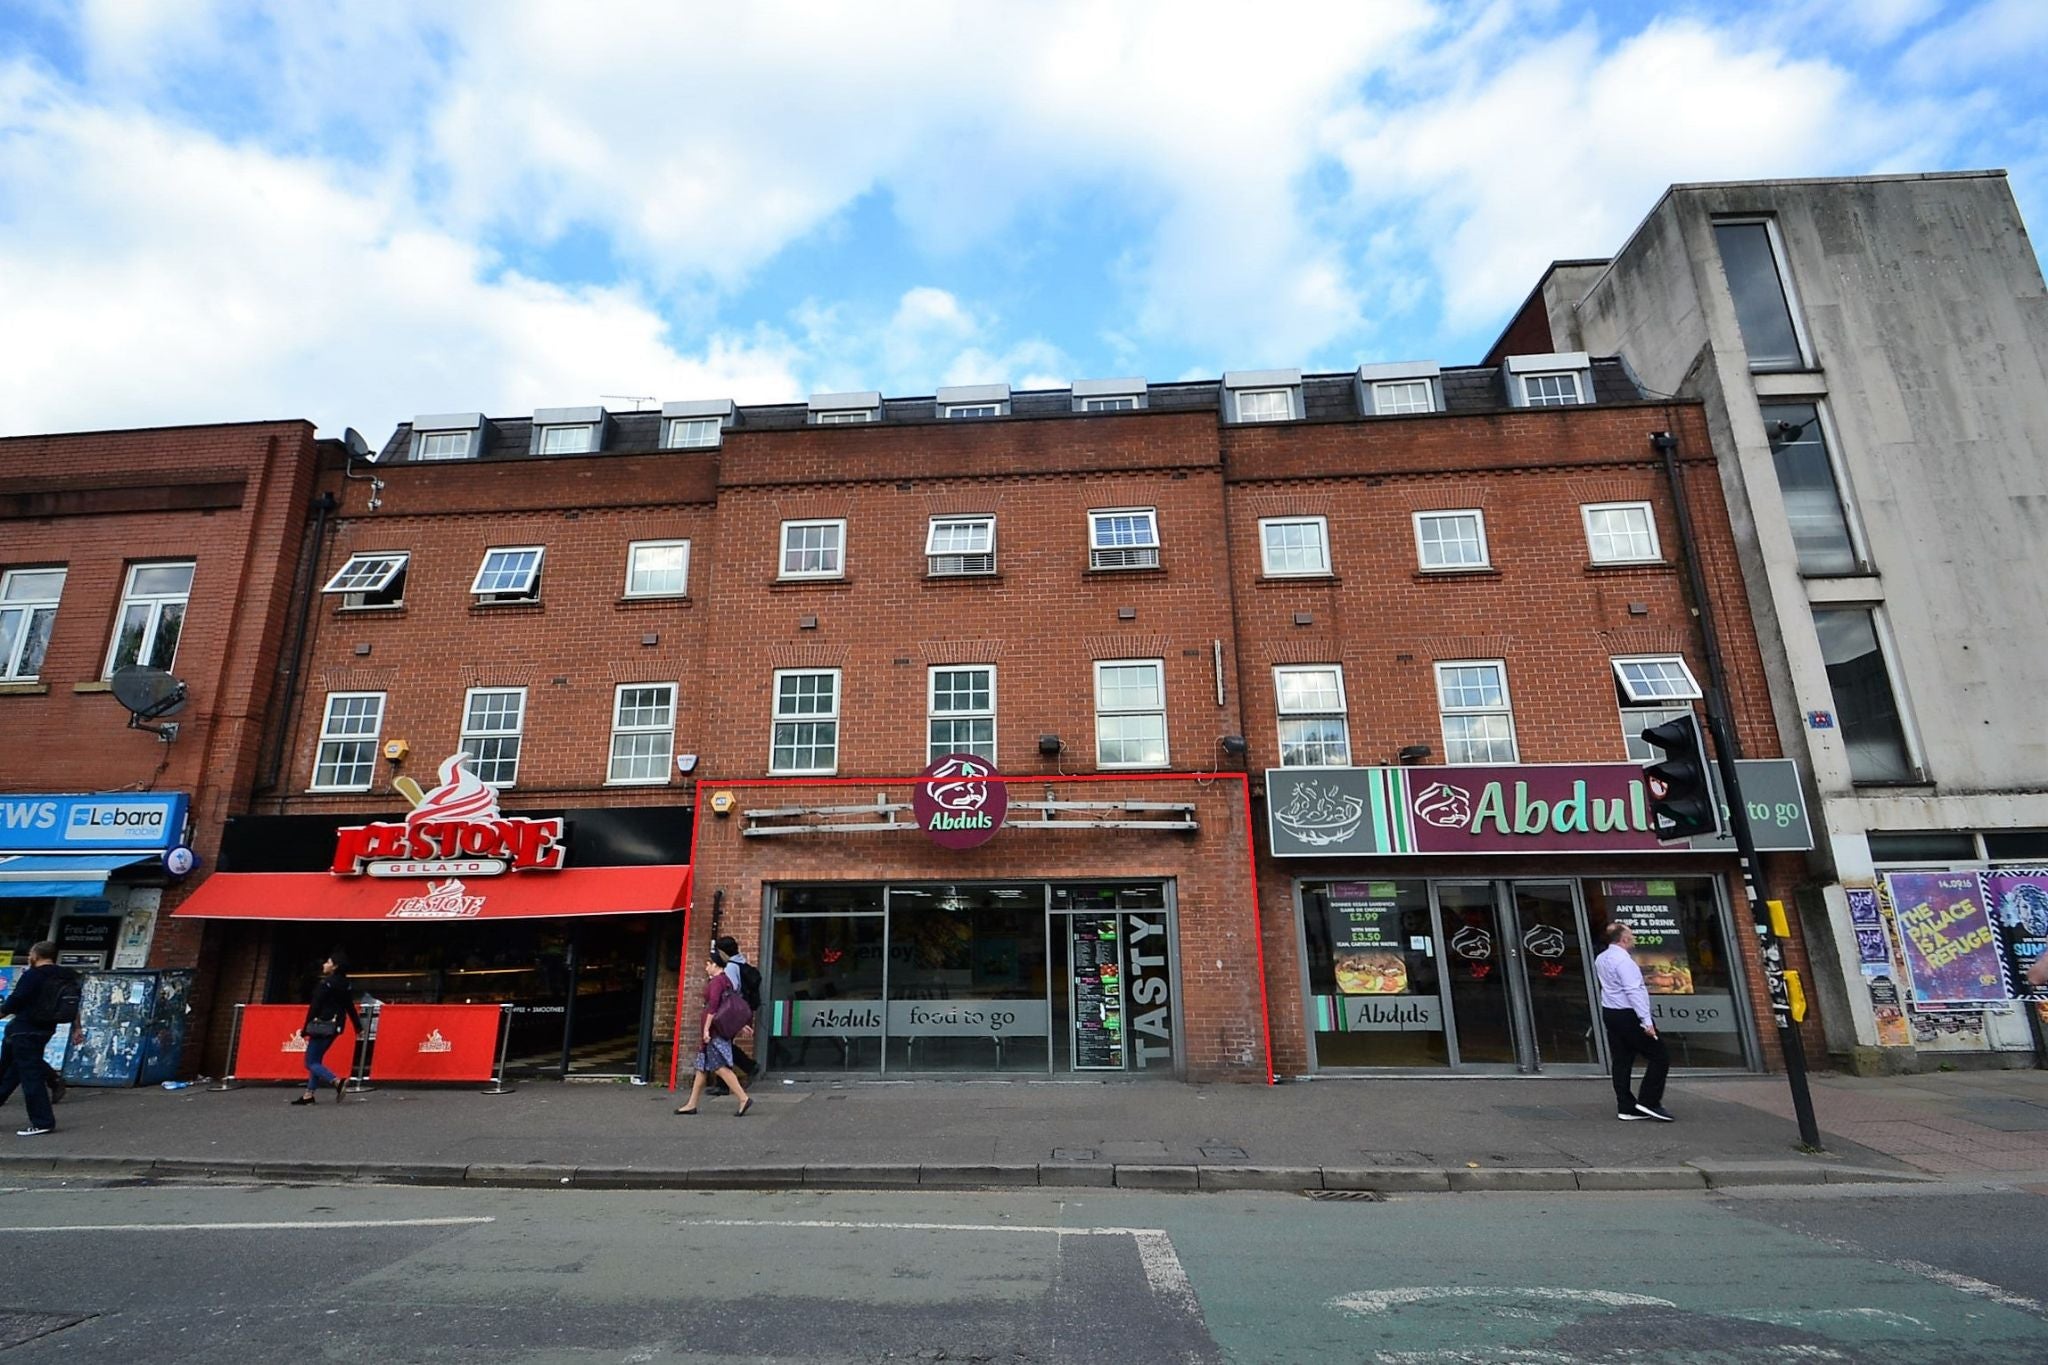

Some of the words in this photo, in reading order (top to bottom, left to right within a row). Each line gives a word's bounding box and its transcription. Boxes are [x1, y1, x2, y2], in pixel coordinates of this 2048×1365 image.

[90, 807, 163, 826] Lebara
[1470, 779, 1655, 835] Abdul
[1747, 801, 1770, 820] to
[1775, 802, 1799, 828] go
[124, 827, 159, 836] mobile
[928, 810, 993, 831] Abduls
[331, 817, 566, 876] ICESTONE
[390, 863, 480, 873] GELATO
[386, 896, 486, 918] ICESTONE
[1350, 913, 1378, 921] £2.99
[1899, 902, 1934, 928] THE
[1906, 898, 1977, 942] PALACE
[1352, 932, 1381, 941] £3.50
[1916, 938, 1935, 956] IS
[1932, 932, 1949, 948] A
[1925, 926, 1993, 970] REFUGE
[1129, 914, 1171, 1068] TASTY
[812, 1008, 881, 1028] Abduls
[910, 1005, 957, 1025] food
[964, 1009, 984, 1025] to
[990, 1010, 1015, 1031] go
[1358, 1003, 1429, 1024] Abduls
[1670, 1006, 1689, 1018] to
[1695, 1008, 1719, 1023] go
